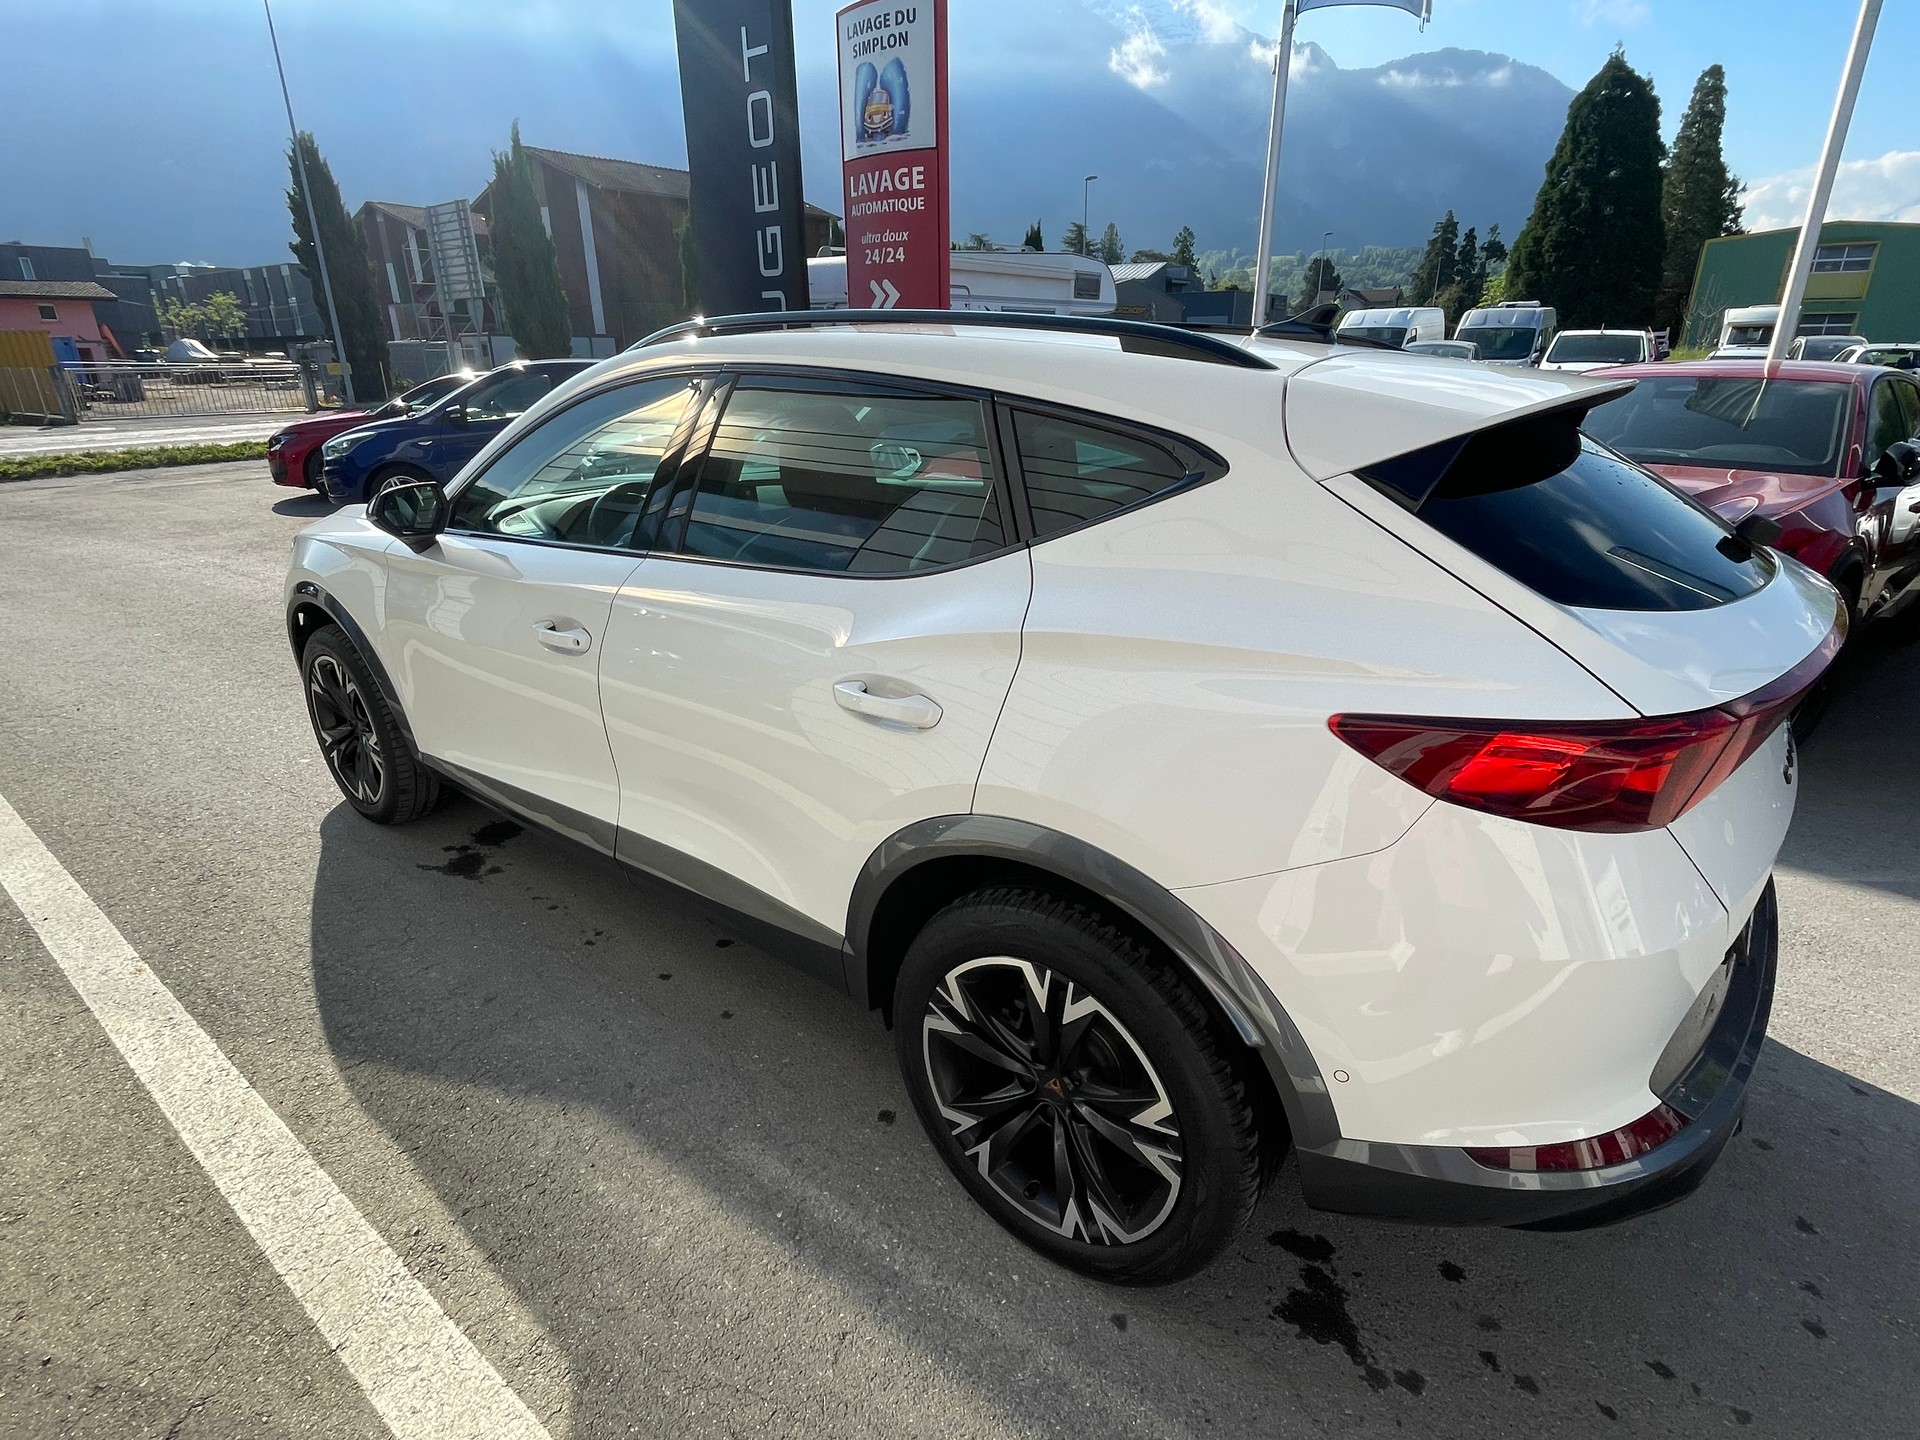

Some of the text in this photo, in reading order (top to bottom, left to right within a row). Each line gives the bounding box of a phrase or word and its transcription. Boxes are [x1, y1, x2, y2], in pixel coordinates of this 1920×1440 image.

[847, 7, 917, 41] LAVAGE DU
[852, 31, 909, 59] SIMPLON
[850, 166, 925, 198] LAVAGE
[851, 196, 925, 217] AUTOMATIQUE
[861, 229, 909, 245] ultra doux
[865, 246, 905, 265] 24/24
